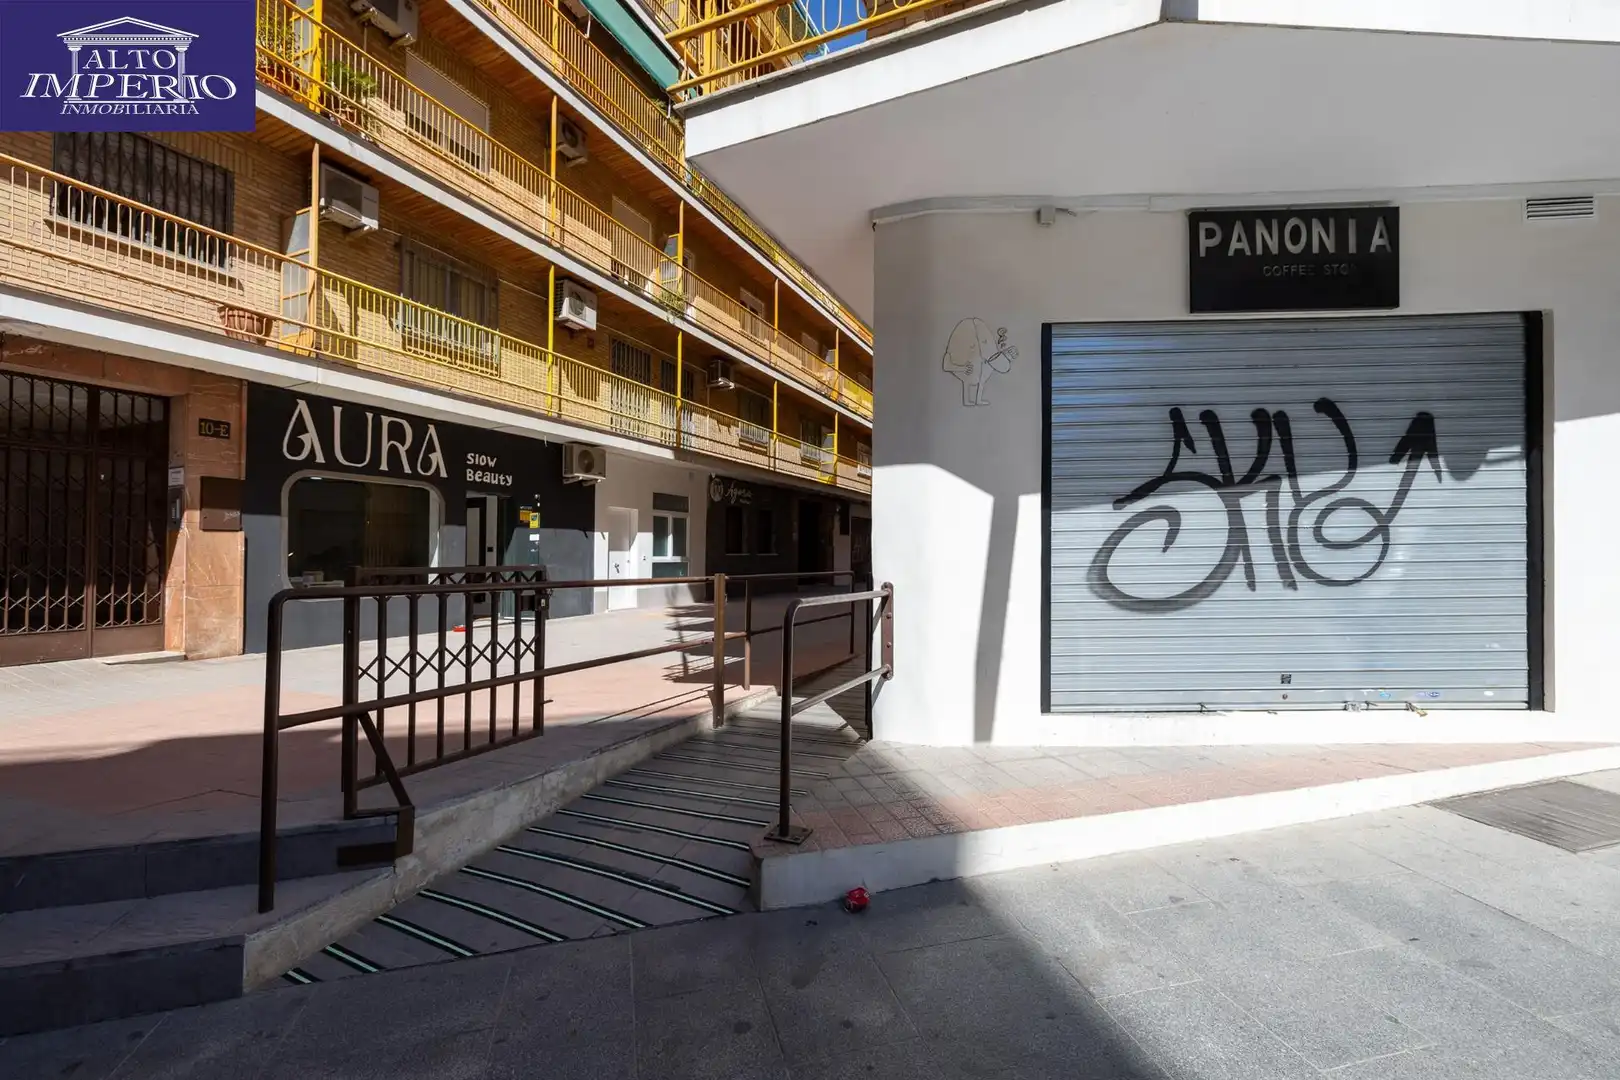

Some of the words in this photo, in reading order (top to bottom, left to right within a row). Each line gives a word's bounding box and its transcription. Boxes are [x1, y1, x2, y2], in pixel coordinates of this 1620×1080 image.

[1199, 216, 1392, 257] PANONIA
[1263, 264, 1316, 277] COFFEE
[200, 422, 229, 437] 10-E
[283, 399, 448, 479] AURA
[466, 470, 514, 486] Beauty
